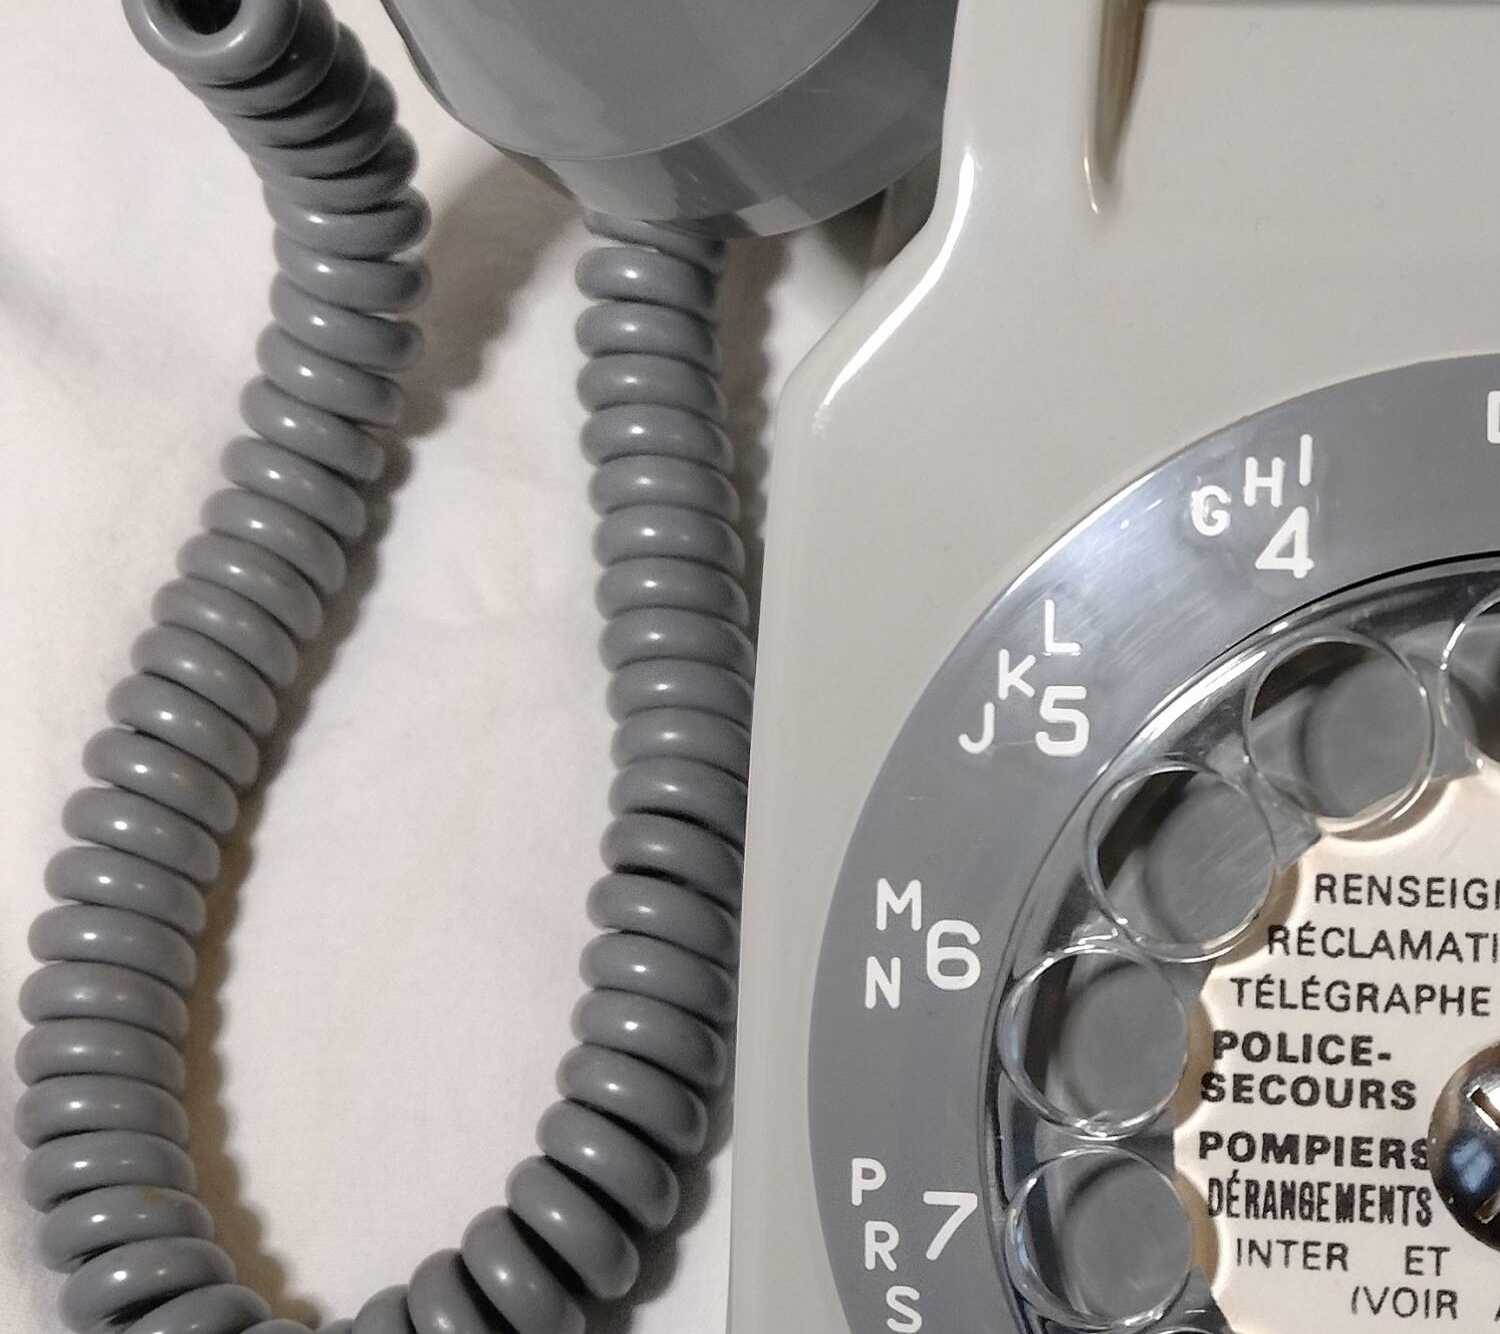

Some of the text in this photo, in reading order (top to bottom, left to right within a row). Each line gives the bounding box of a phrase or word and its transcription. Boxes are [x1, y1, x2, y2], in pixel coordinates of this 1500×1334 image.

[1190, 434, 1314, 538] GHI
[1254, 505, 1315, 580] 4
[1034, 685, 1090, 757] 5
[925, 919, 982, 991] 6
[1231, 973, 1492, 1018] TÉLÉGRAPHE
[1212, 1029, 1392, 1067] POLICE-
[1200, 1073, 1418, 1111] SECOURS
[923, 1191, 979, 1261] 7
[1207, 1173, 1434, 1227] DÉRANGEMENTS
[1236, 1237, 1349, 1272] INTER
[1404, 1246, 1452, 1277] ET
[1350, 1286, 1460, 1321] (VOIR
